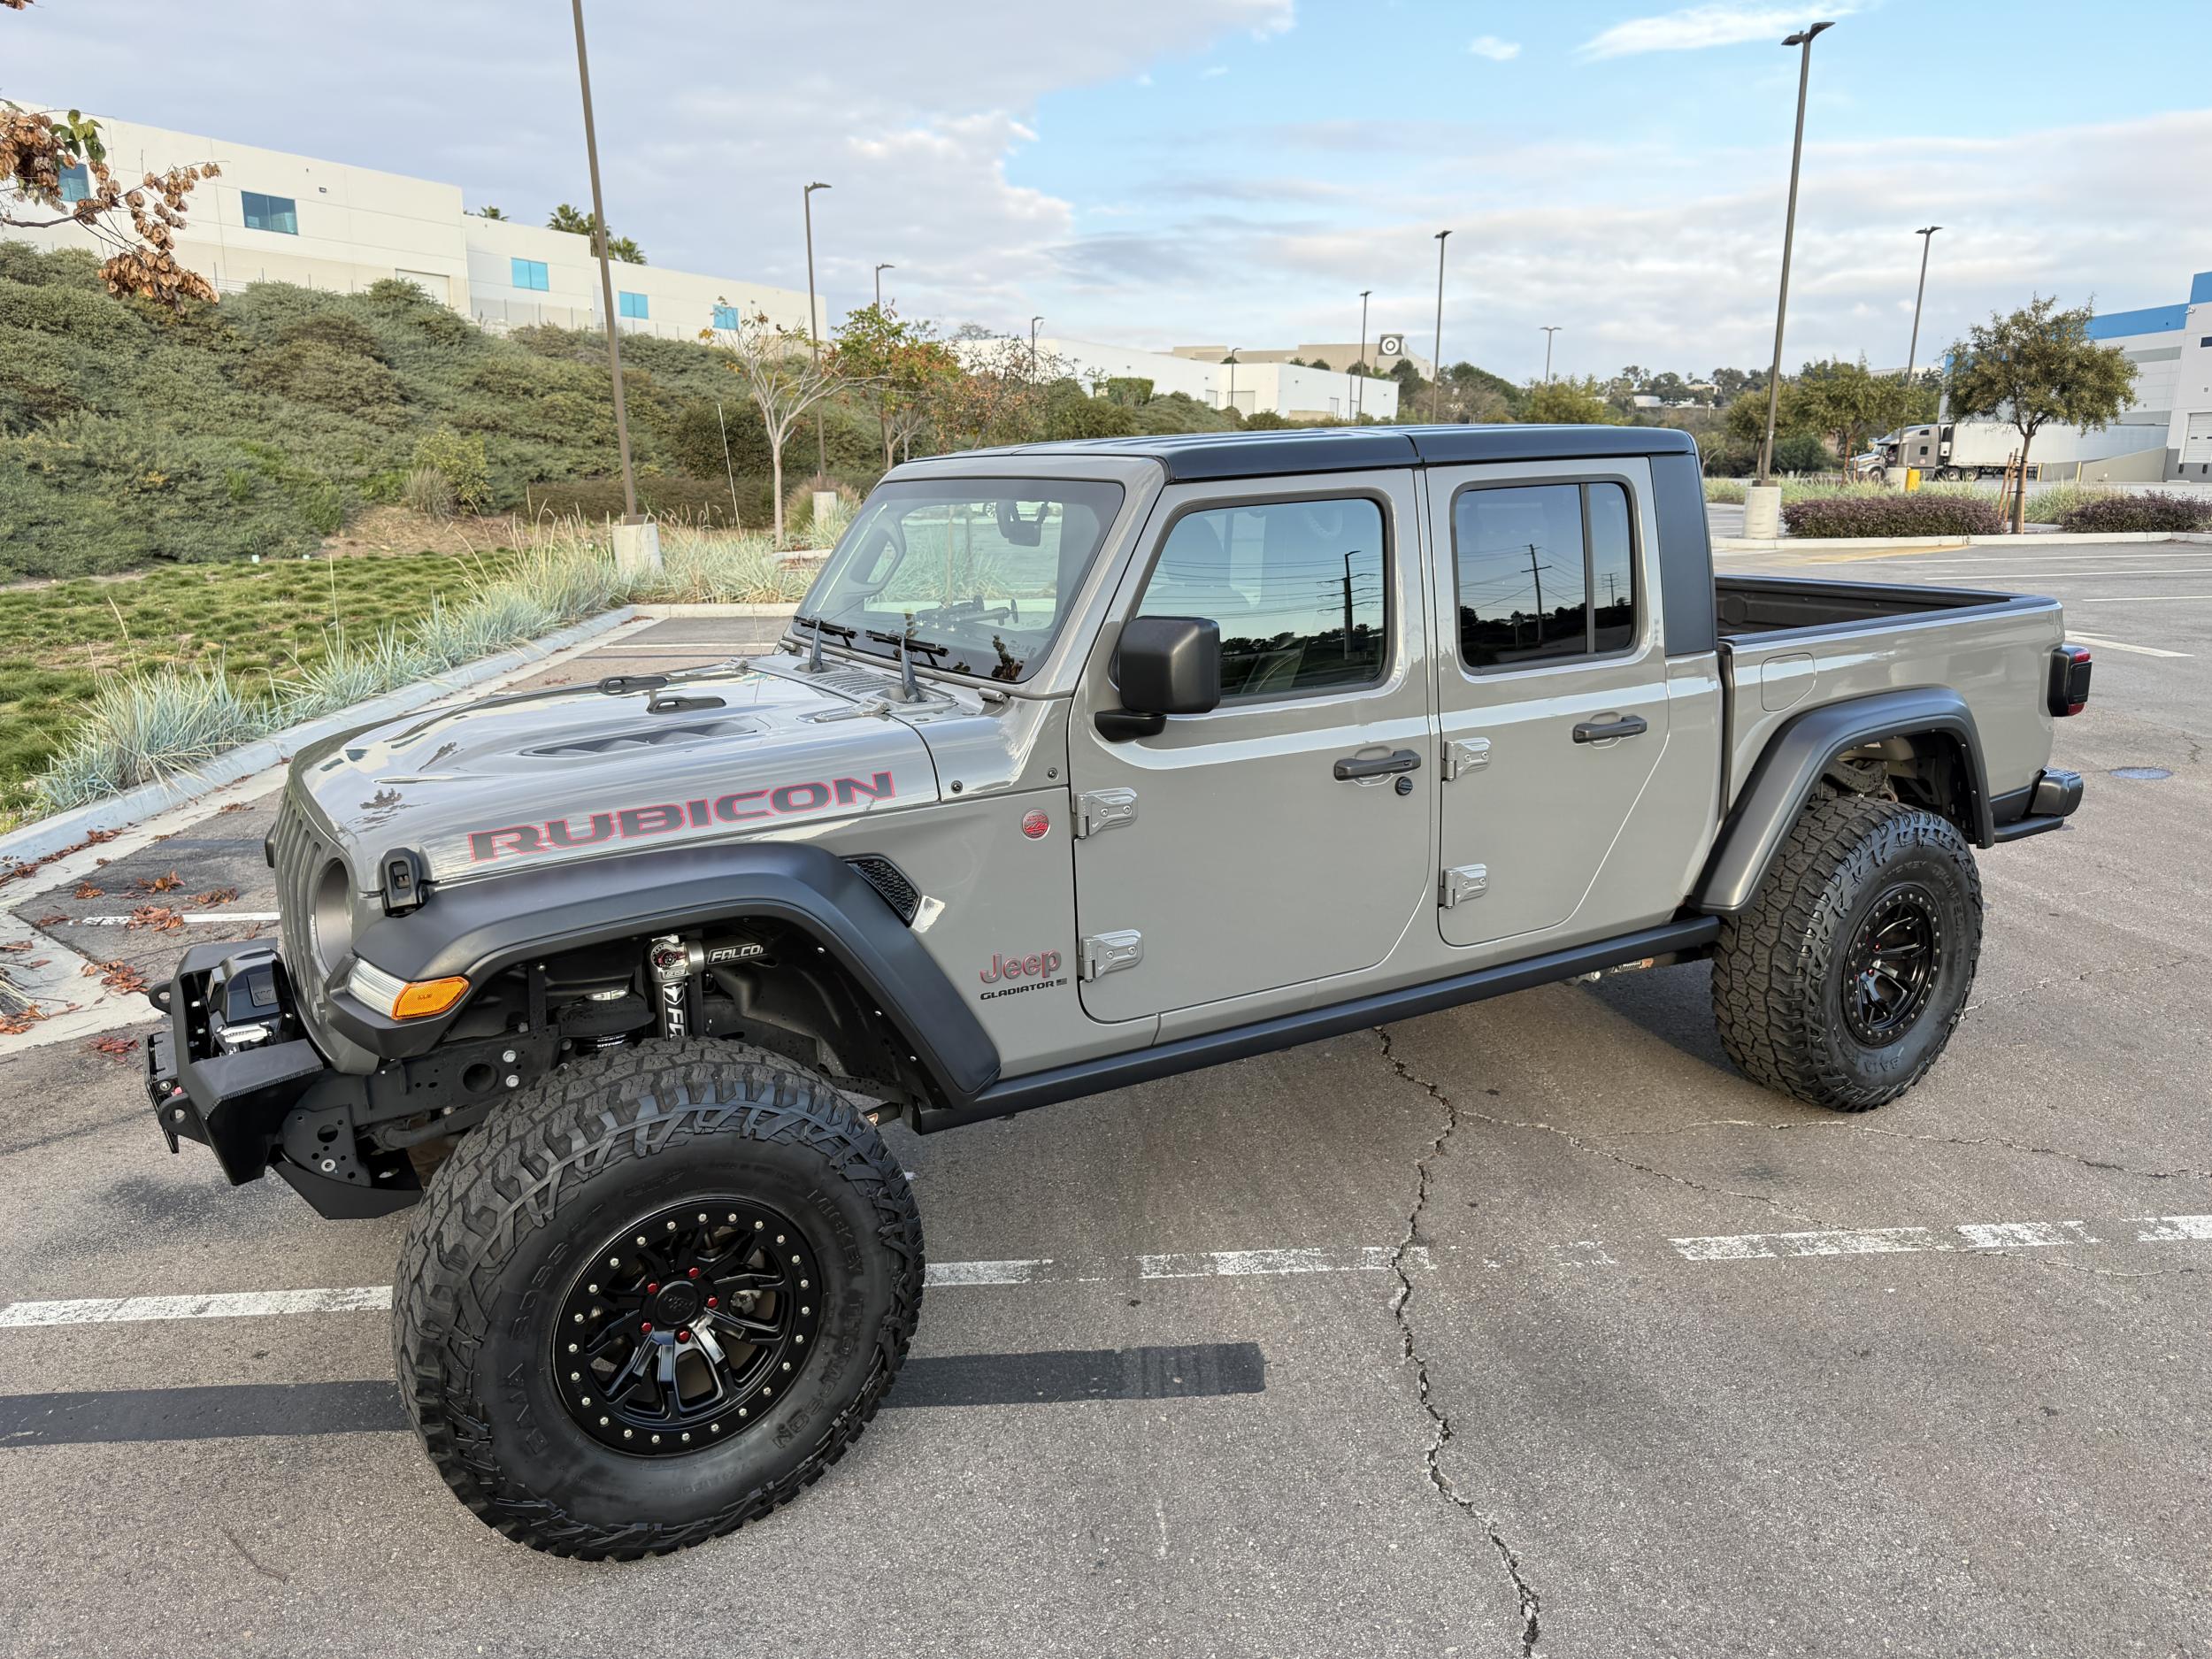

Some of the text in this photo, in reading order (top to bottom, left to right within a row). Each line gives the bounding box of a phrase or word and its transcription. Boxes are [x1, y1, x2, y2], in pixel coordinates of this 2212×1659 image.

[467, 771, 896, 862] RUBICON
[711, 945, 764, 963] FALCO
[979, 948, 1062, 984] Jeep
[979, 979, 1055, 1001] GLADIATOR
[507, 1241, 570, 1455] BAJA BOSS
[772, 1187, 864, 1449] MICKEY THOMPSON
